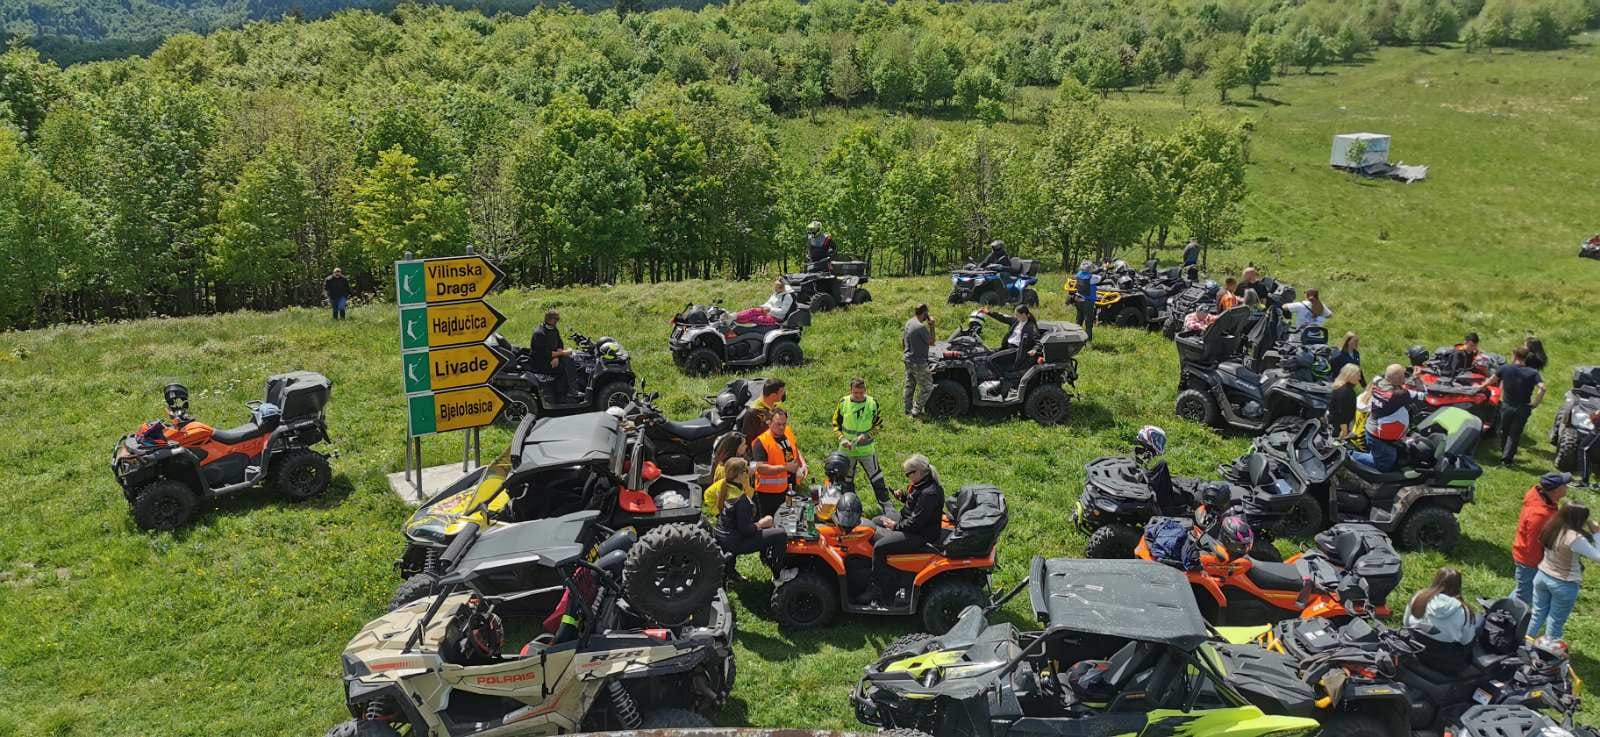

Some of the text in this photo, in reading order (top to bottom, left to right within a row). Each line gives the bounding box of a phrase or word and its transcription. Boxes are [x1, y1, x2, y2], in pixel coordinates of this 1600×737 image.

[427, 263, 482, 279] Vilinska
[436, 282, 476, 296] Draga
[435, 357, 488, 377] Livade
[440, 400, 493, 421] Bjelolasica
[477, 672, 536, 685] POLARIS
